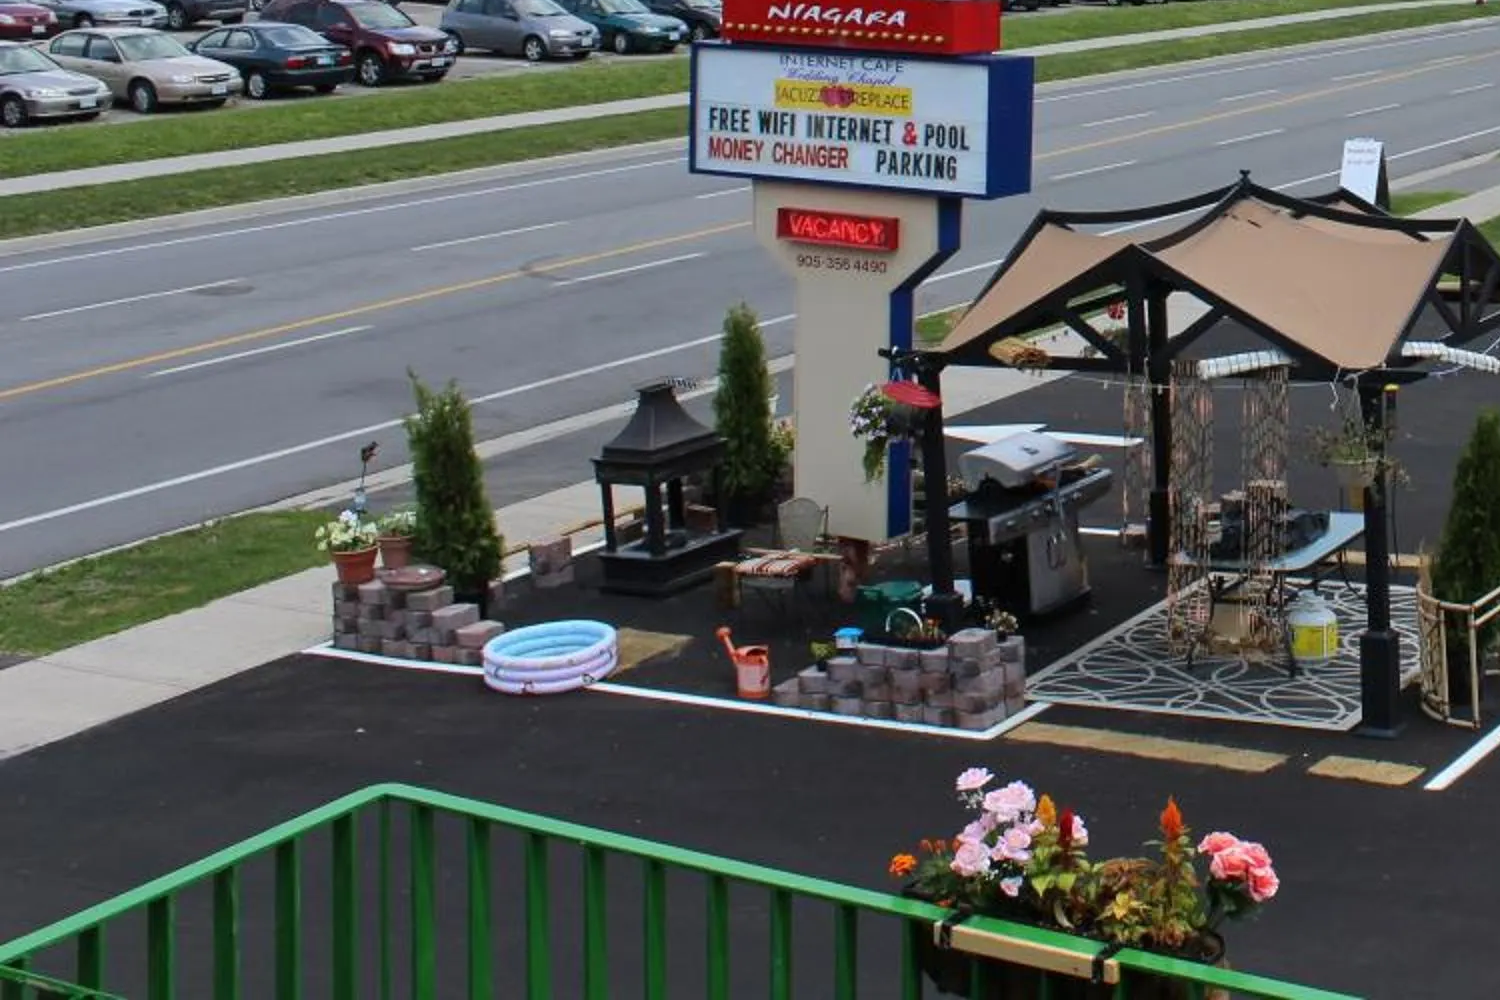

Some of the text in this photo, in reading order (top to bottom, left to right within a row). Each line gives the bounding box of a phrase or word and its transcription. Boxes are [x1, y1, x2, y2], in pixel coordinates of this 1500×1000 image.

[768, 2, 906, 27] NIAGARA
[780, 54, 855, 70] INTERNET
[709, 107, 970, 151] FREE WIFI INTERNET & POOL
[708, 137, 957, 180] MONEY CHANGER PARKING
[790, 214, 885, 244] VACANCY
